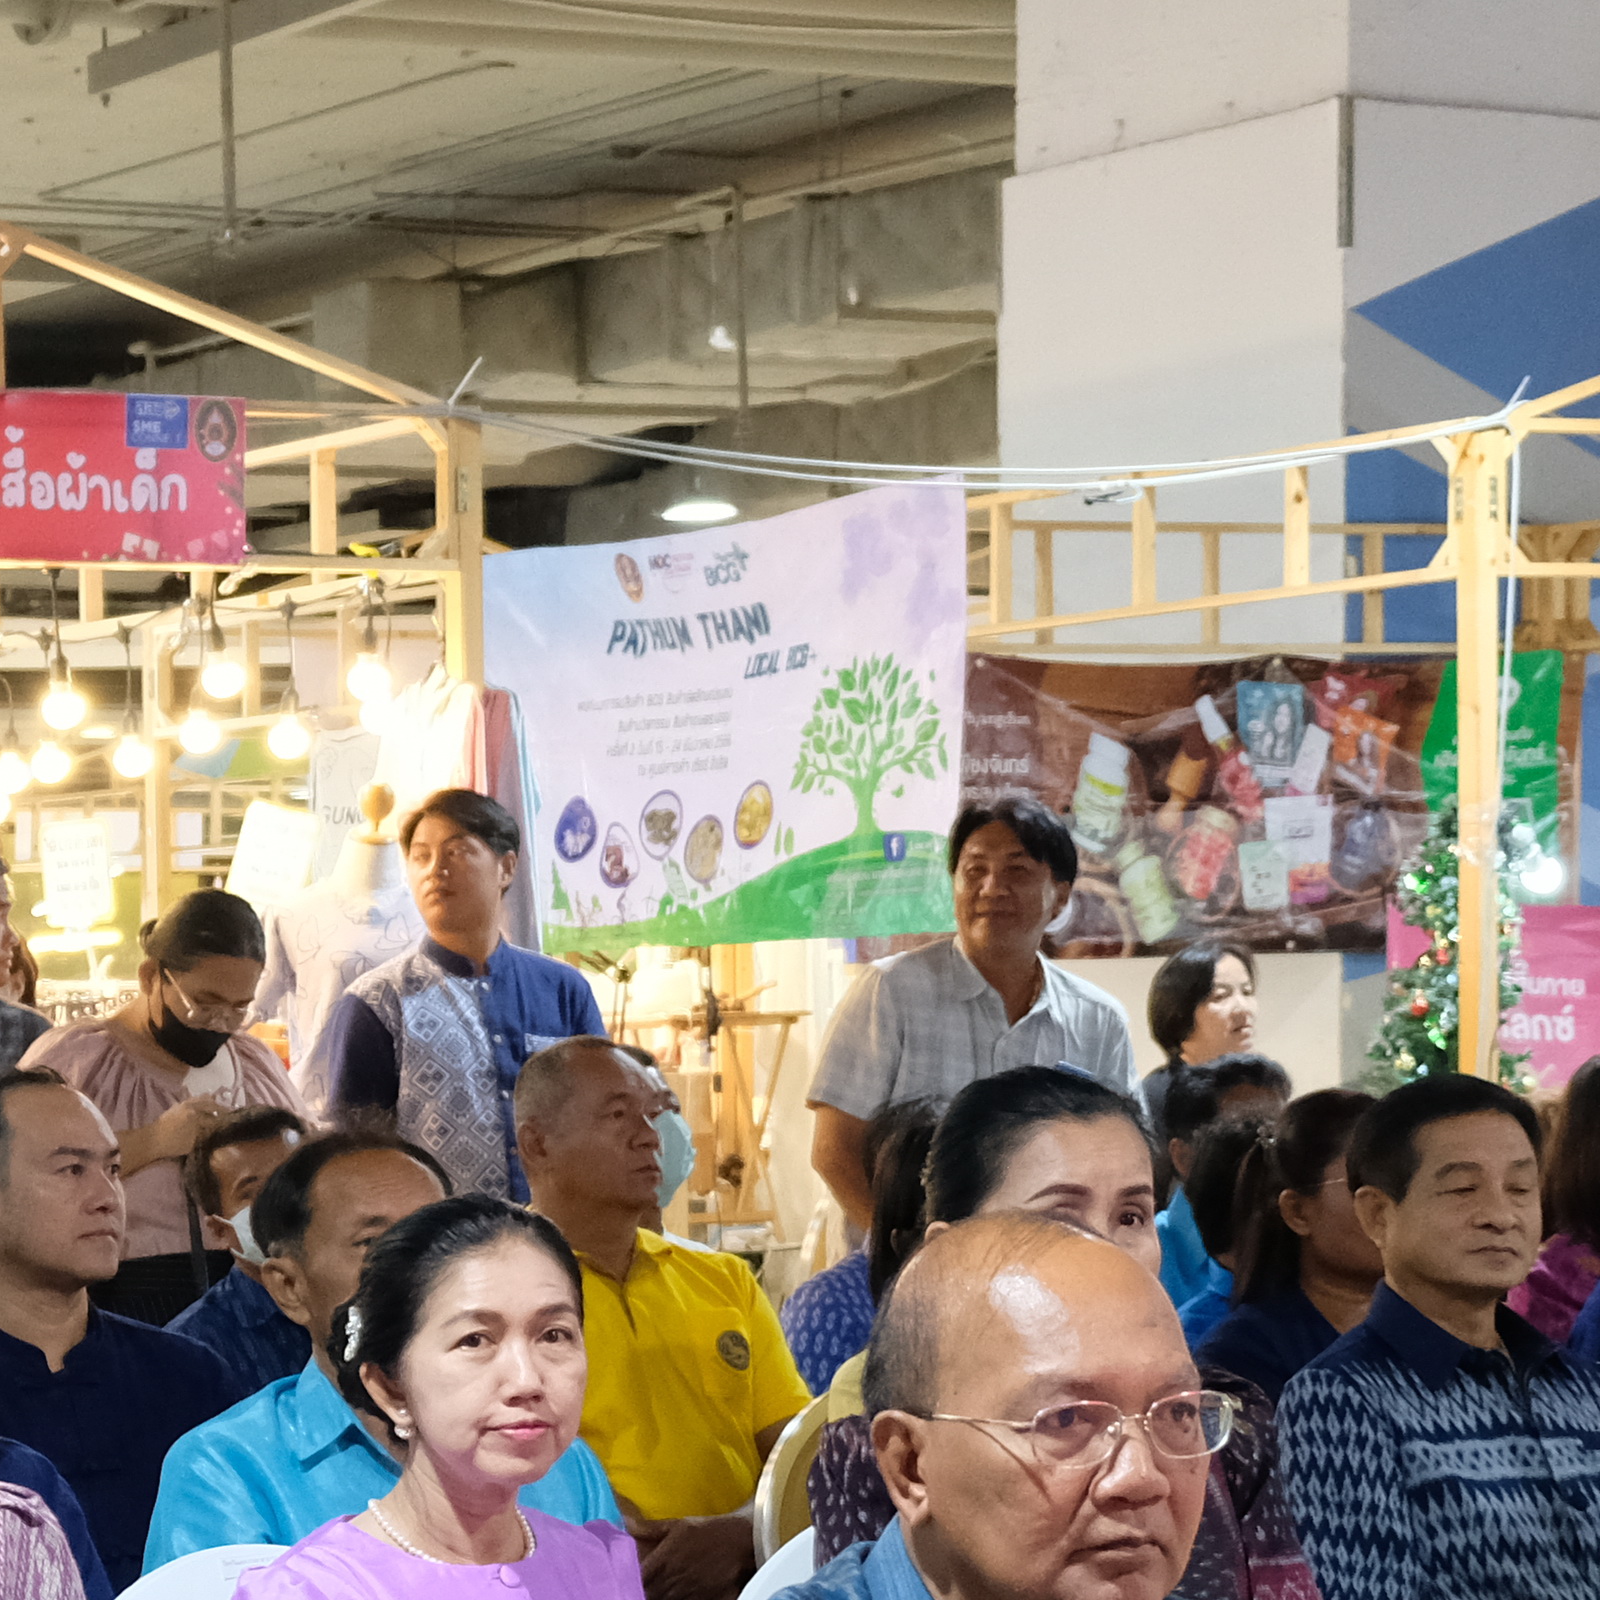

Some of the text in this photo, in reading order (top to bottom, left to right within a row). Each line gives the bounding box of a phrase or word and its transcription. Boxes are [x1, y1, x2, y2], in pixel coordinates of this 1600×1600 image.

[607, 602, 771, 658] PATHUM THANI
[743, 649, 780, 680] LOCAL
